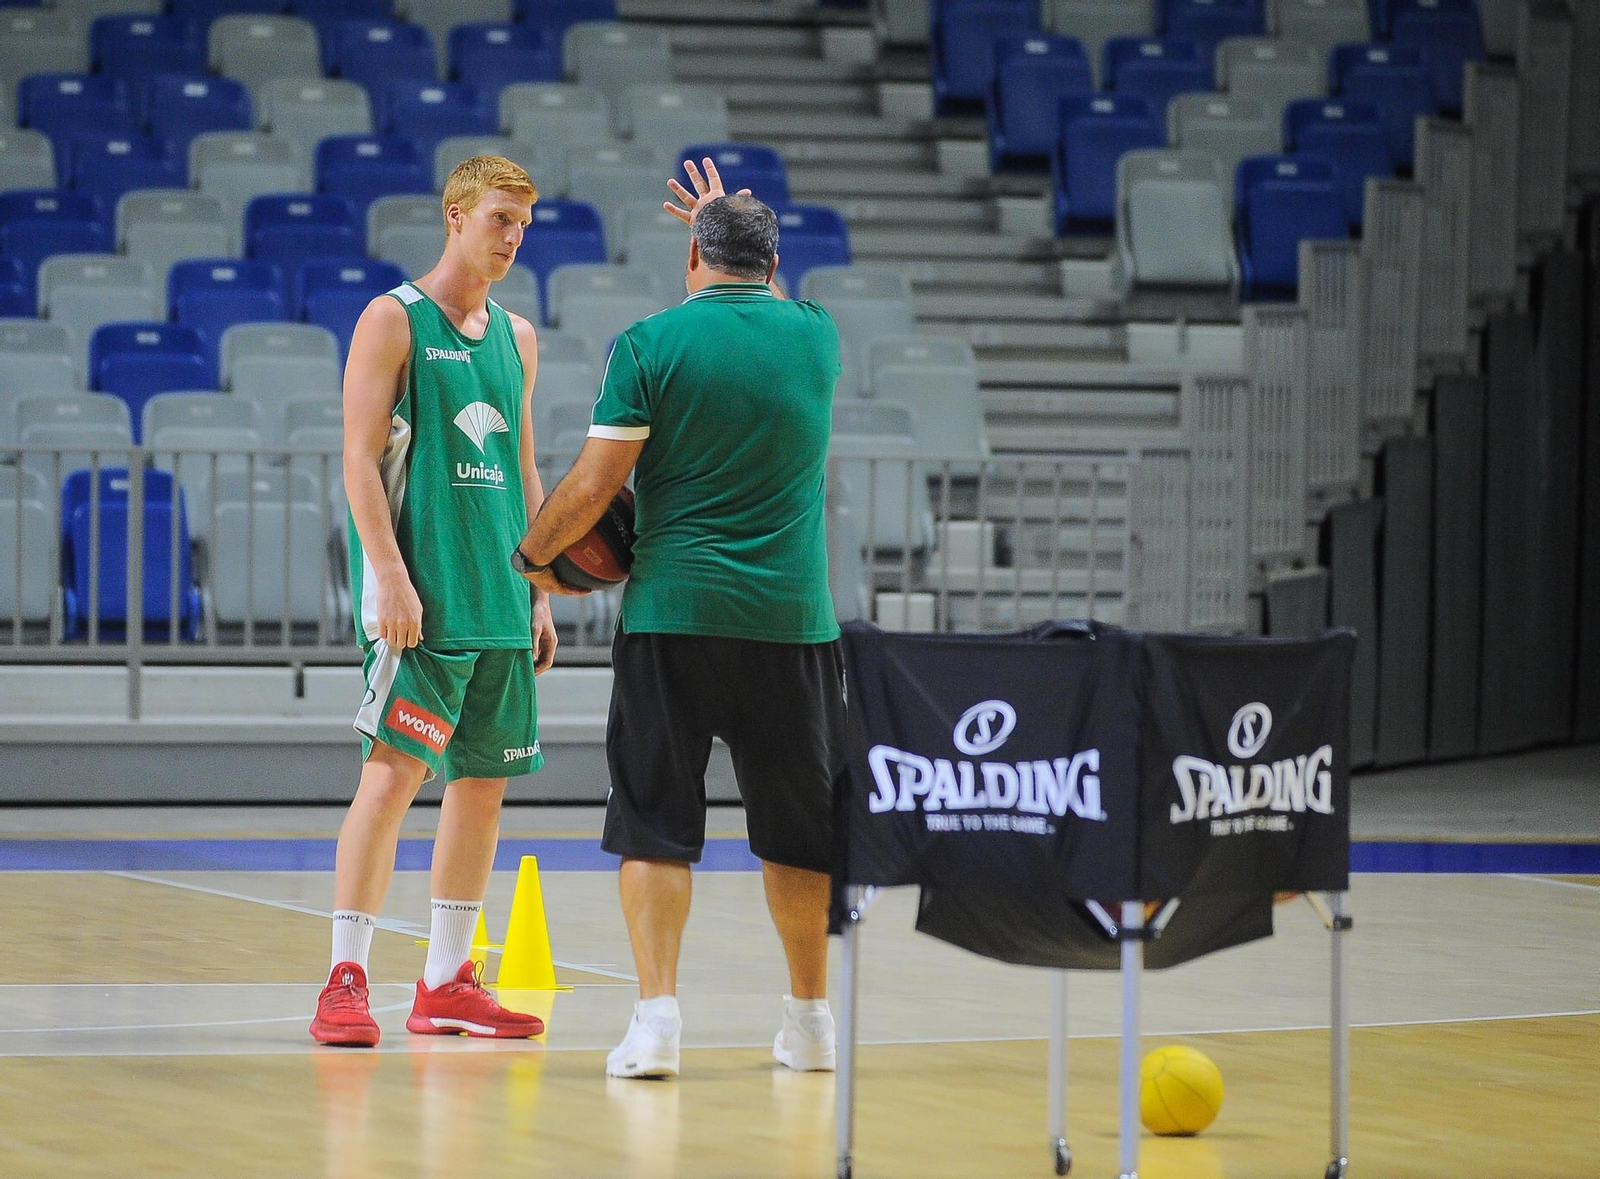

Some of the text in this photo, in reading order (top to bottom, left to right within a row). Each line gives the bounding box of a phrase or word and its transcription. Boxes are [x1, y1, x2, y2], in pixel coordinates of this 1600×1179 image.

[425, 347, 471, 364] SPALDING
[456, 461, 504, 485] Unicaja
[398, 710, 446, 748] worten
[503, 739, 541, 763] SPALDG
[868, 744, 1101, 821] SPALDING
[1169, 744, 1333, 824] SPALDING
